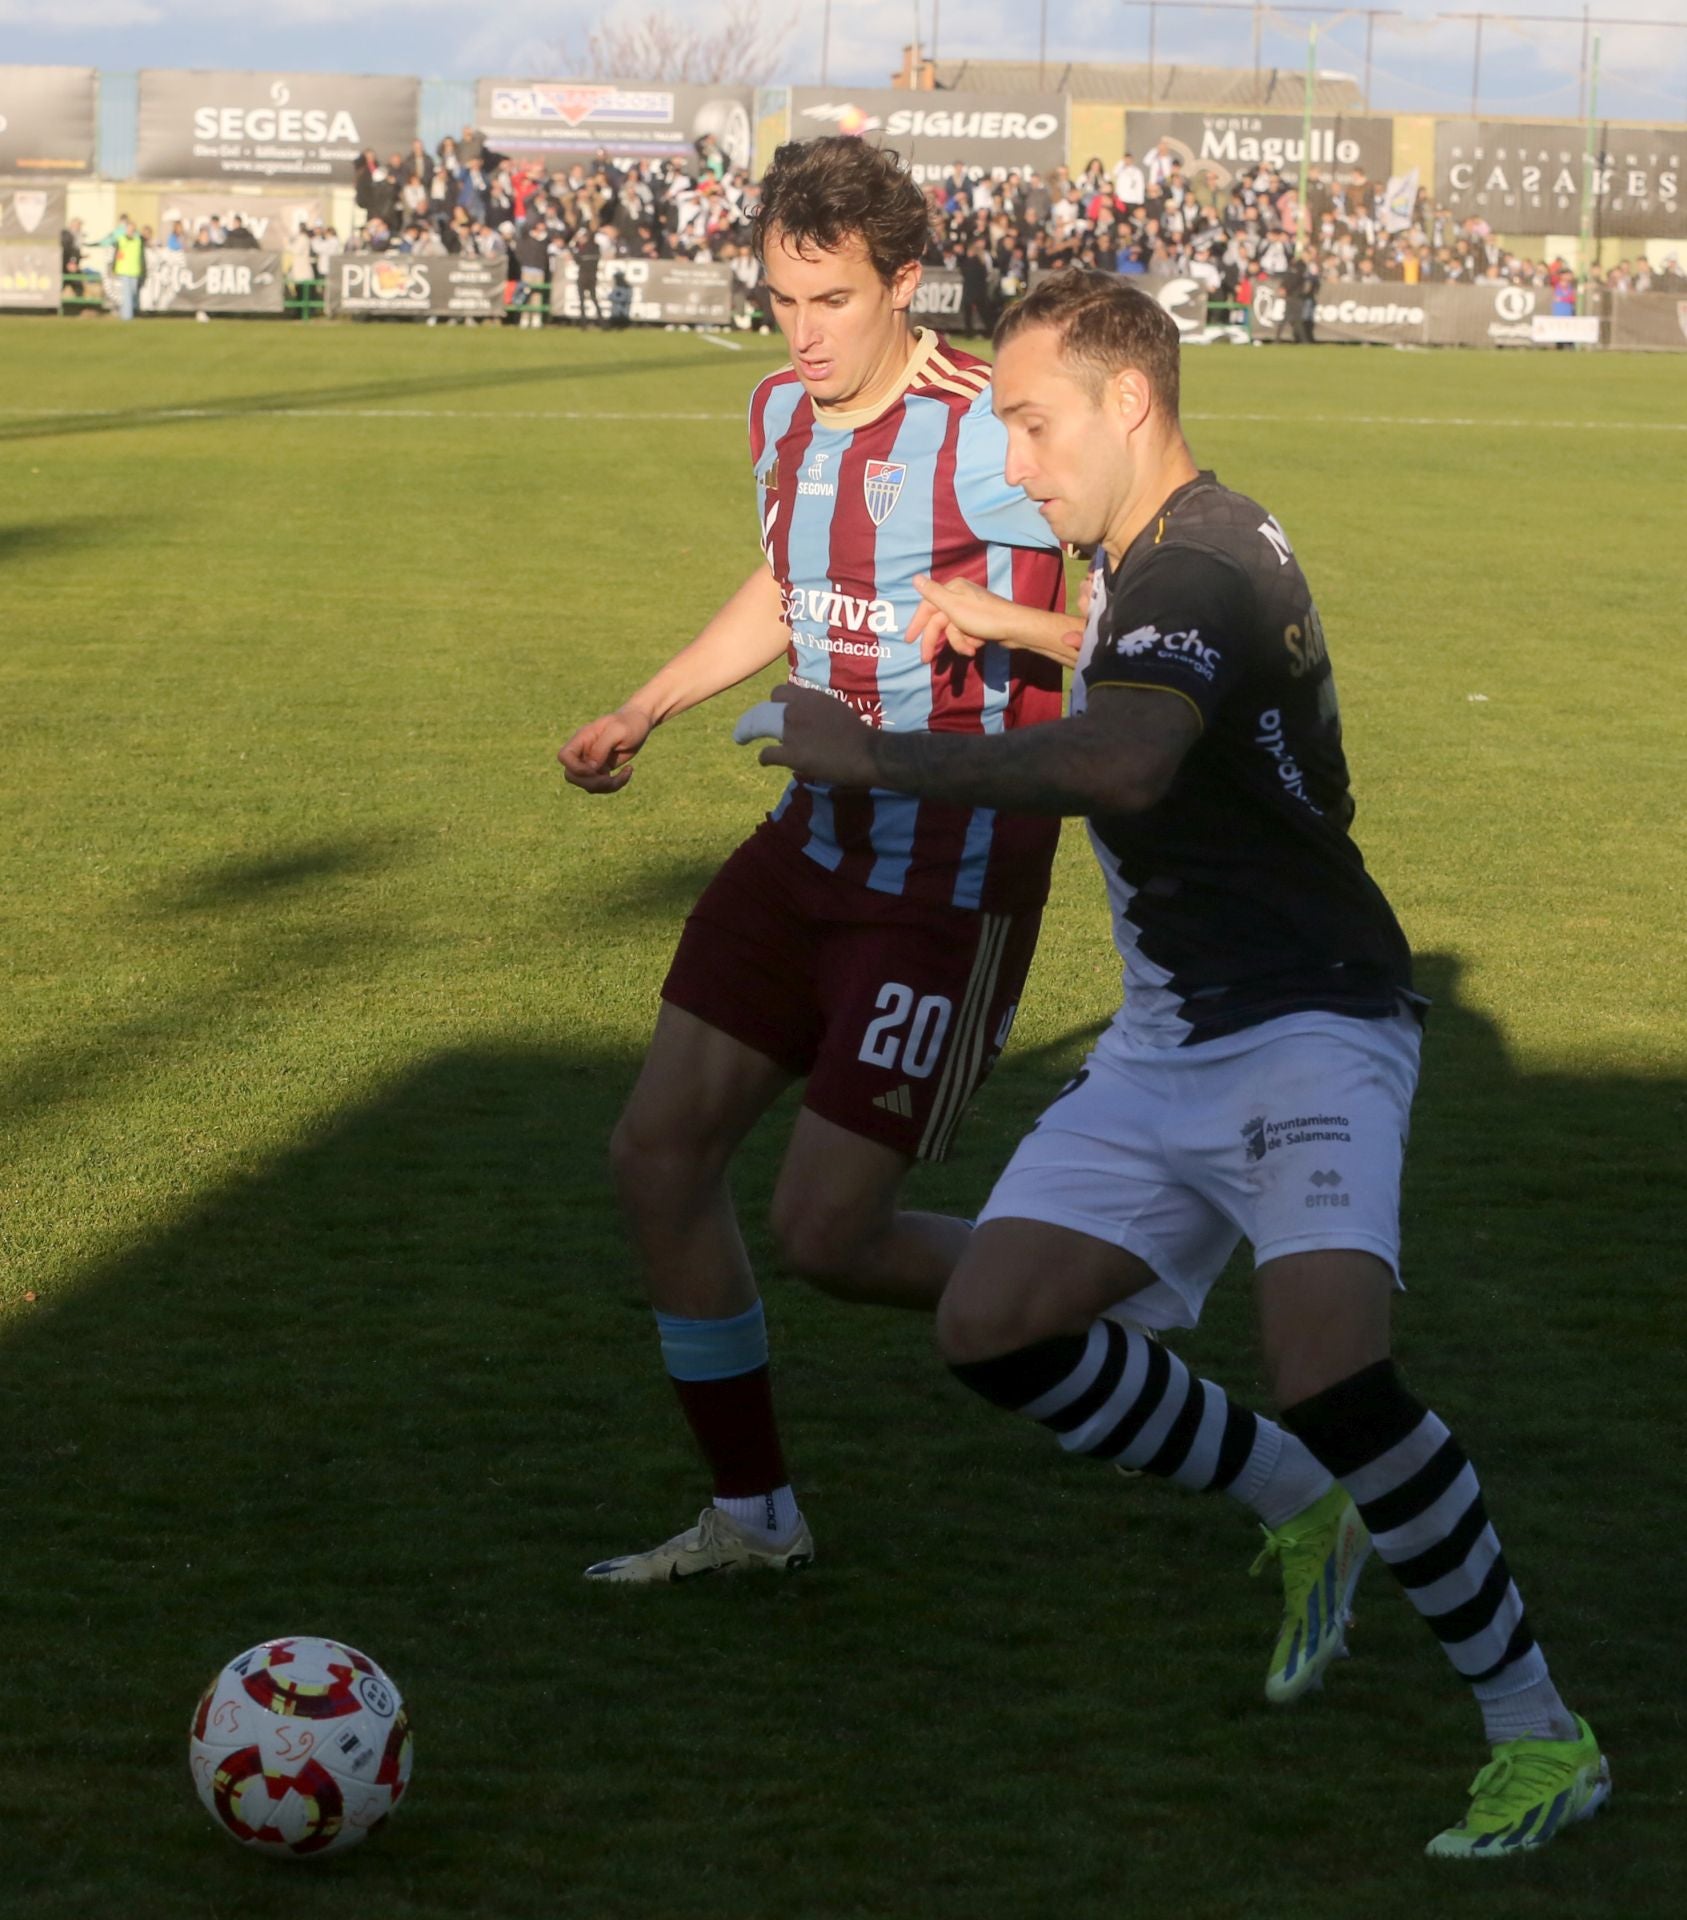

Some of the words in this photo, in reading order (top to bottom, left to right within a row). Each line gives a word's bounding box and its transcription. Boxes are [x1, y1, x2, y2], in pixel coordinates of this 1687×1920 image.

[194, 107, 360, 144] SEGESA
[887, 109, 1059, 141] SIGUERO
[1200, 129, 1361, 169] Magullo
[207, 264, 251, 295] BAR
[798, 481, 834, 497] SEGOVIA
[808, 633, 892, 659] Fundación
[1163, 629, 1221, 670] chc
[858, 981, 953, 1079] 20
[1266, 1114, 1349, 1135] Ayuntamiento
[1268, 1137, 1282, 1151] de
[1286, 1130, 1352, 1146] Salamanca
